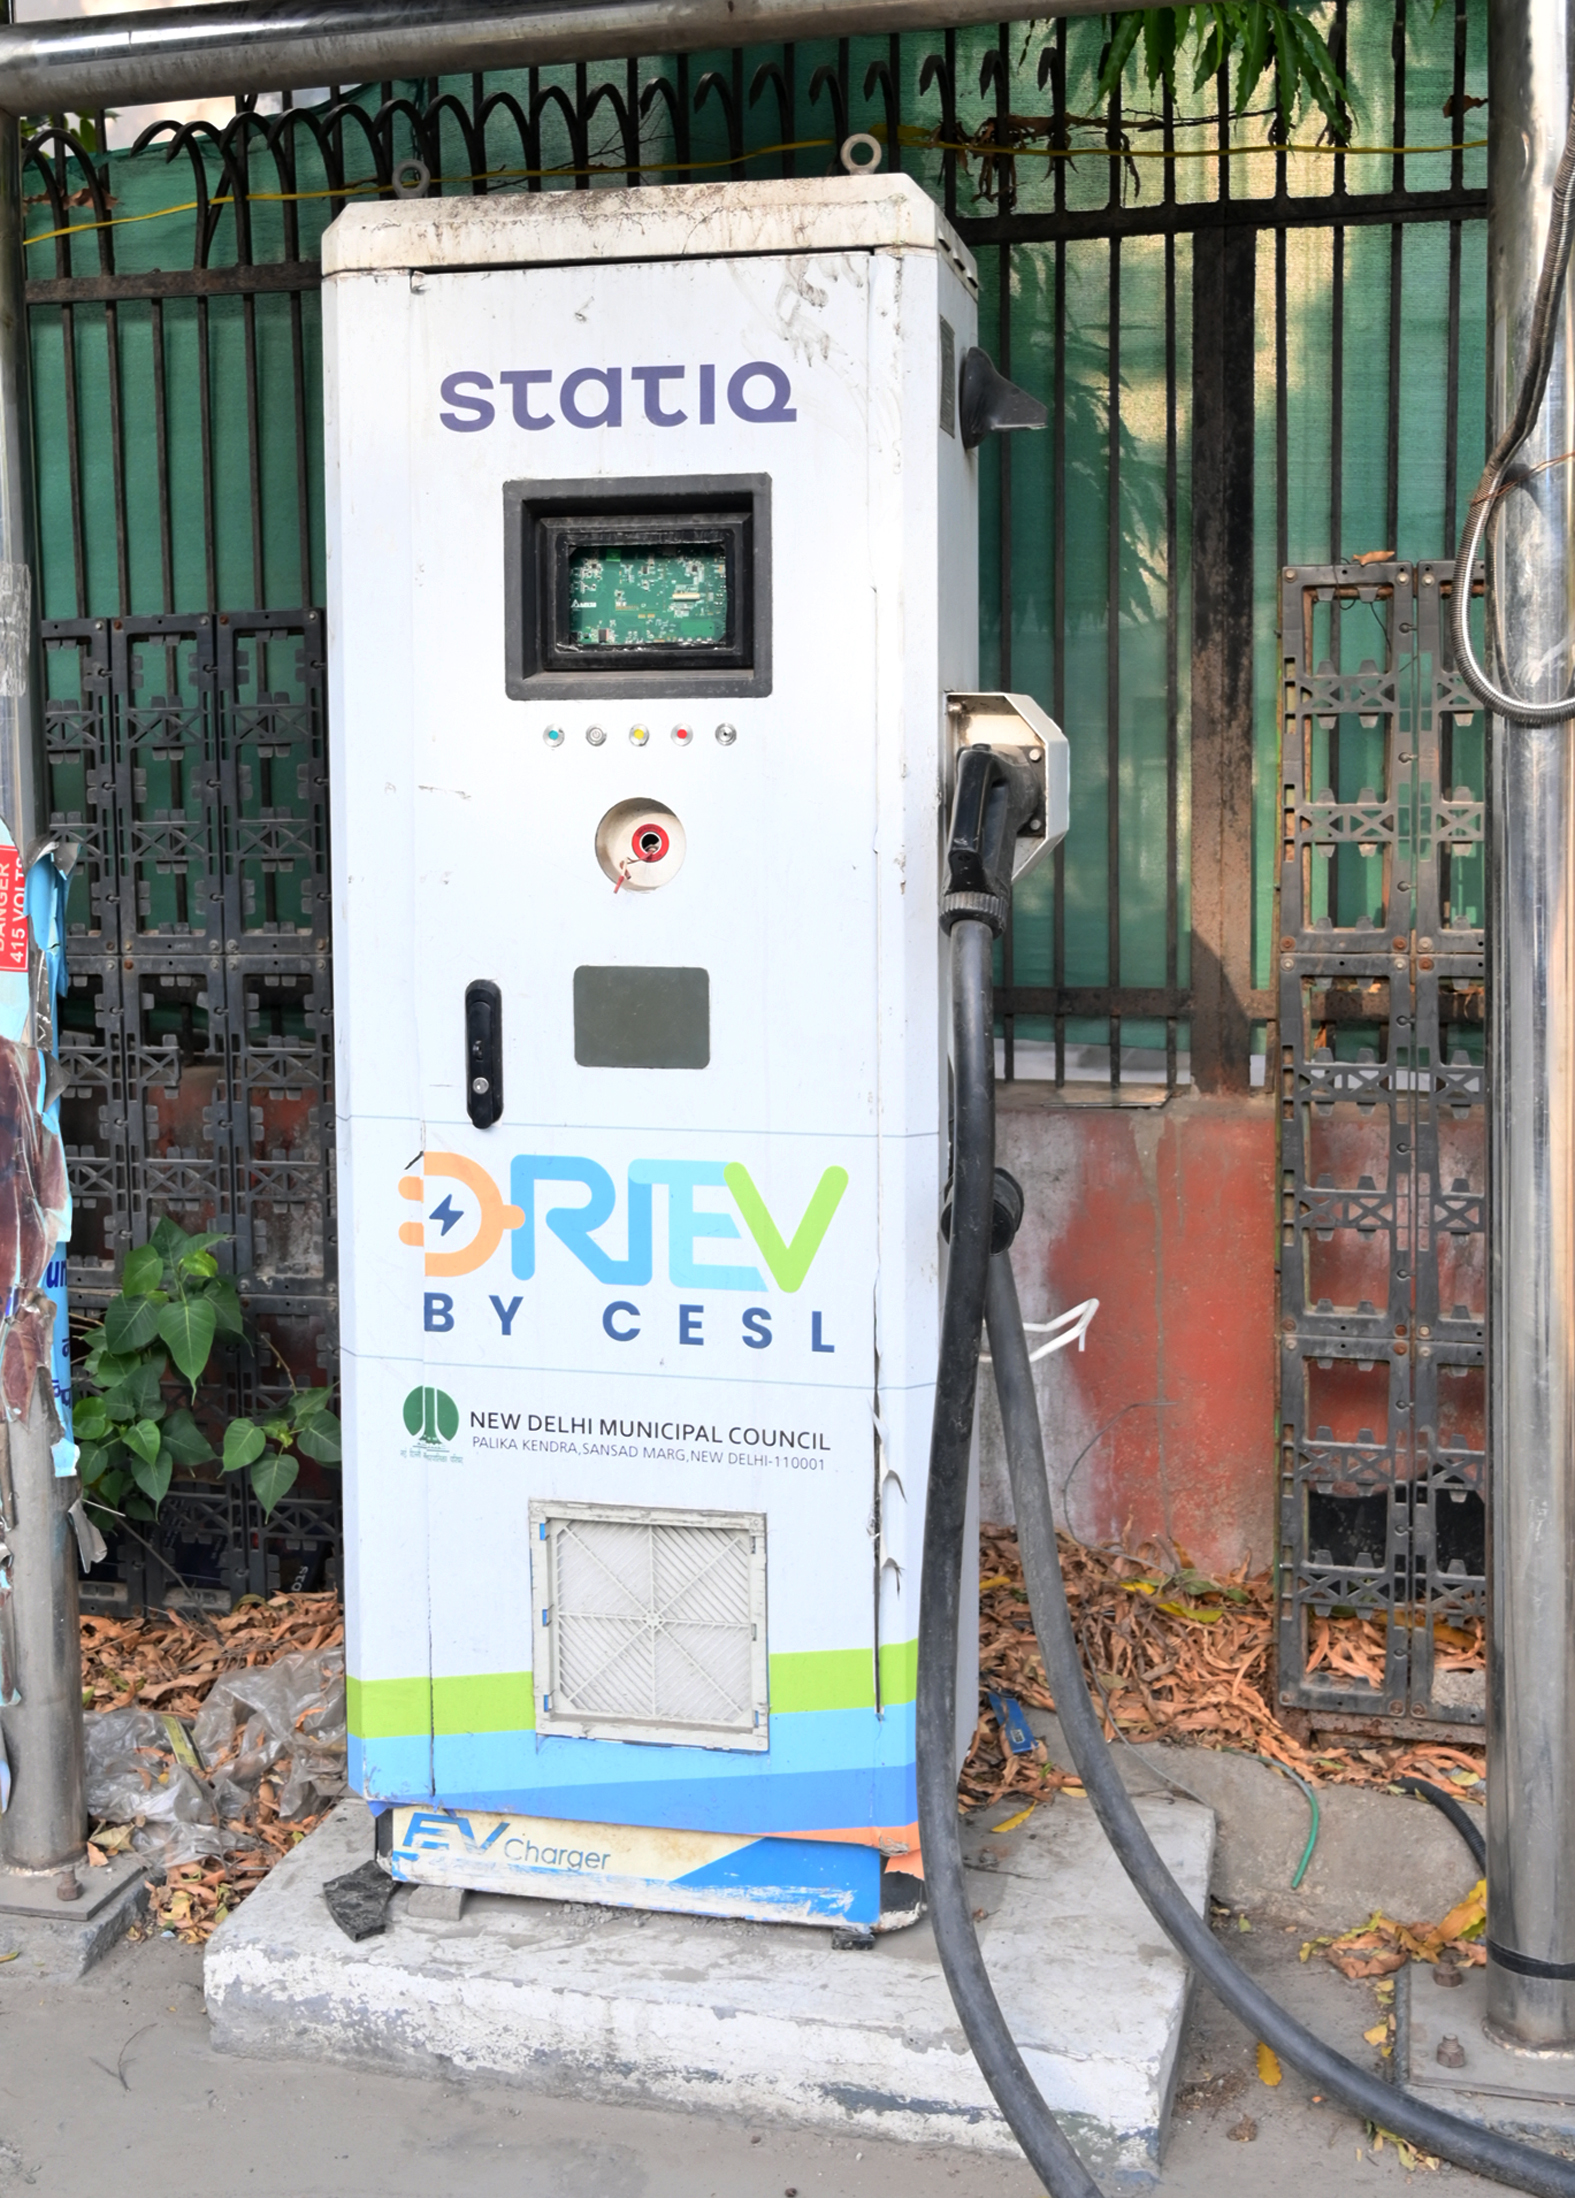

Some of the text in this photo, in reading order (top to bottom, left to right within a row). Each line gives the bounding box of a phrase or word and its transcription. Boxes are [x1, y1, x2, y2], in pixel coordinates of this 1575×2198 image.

[10, 928, 26, 963] 415
[424, 1292, 836, 1354] BY CESL
[470, 1411, 831, 1451] NEW DELHI MUNICIPAL COUNCIL
[472, 1435, 518, 1450] PALIKA
[728, 1452, 825, 1471] DELHI-110001
[403, 1811, 612, 1873] EV Charger
